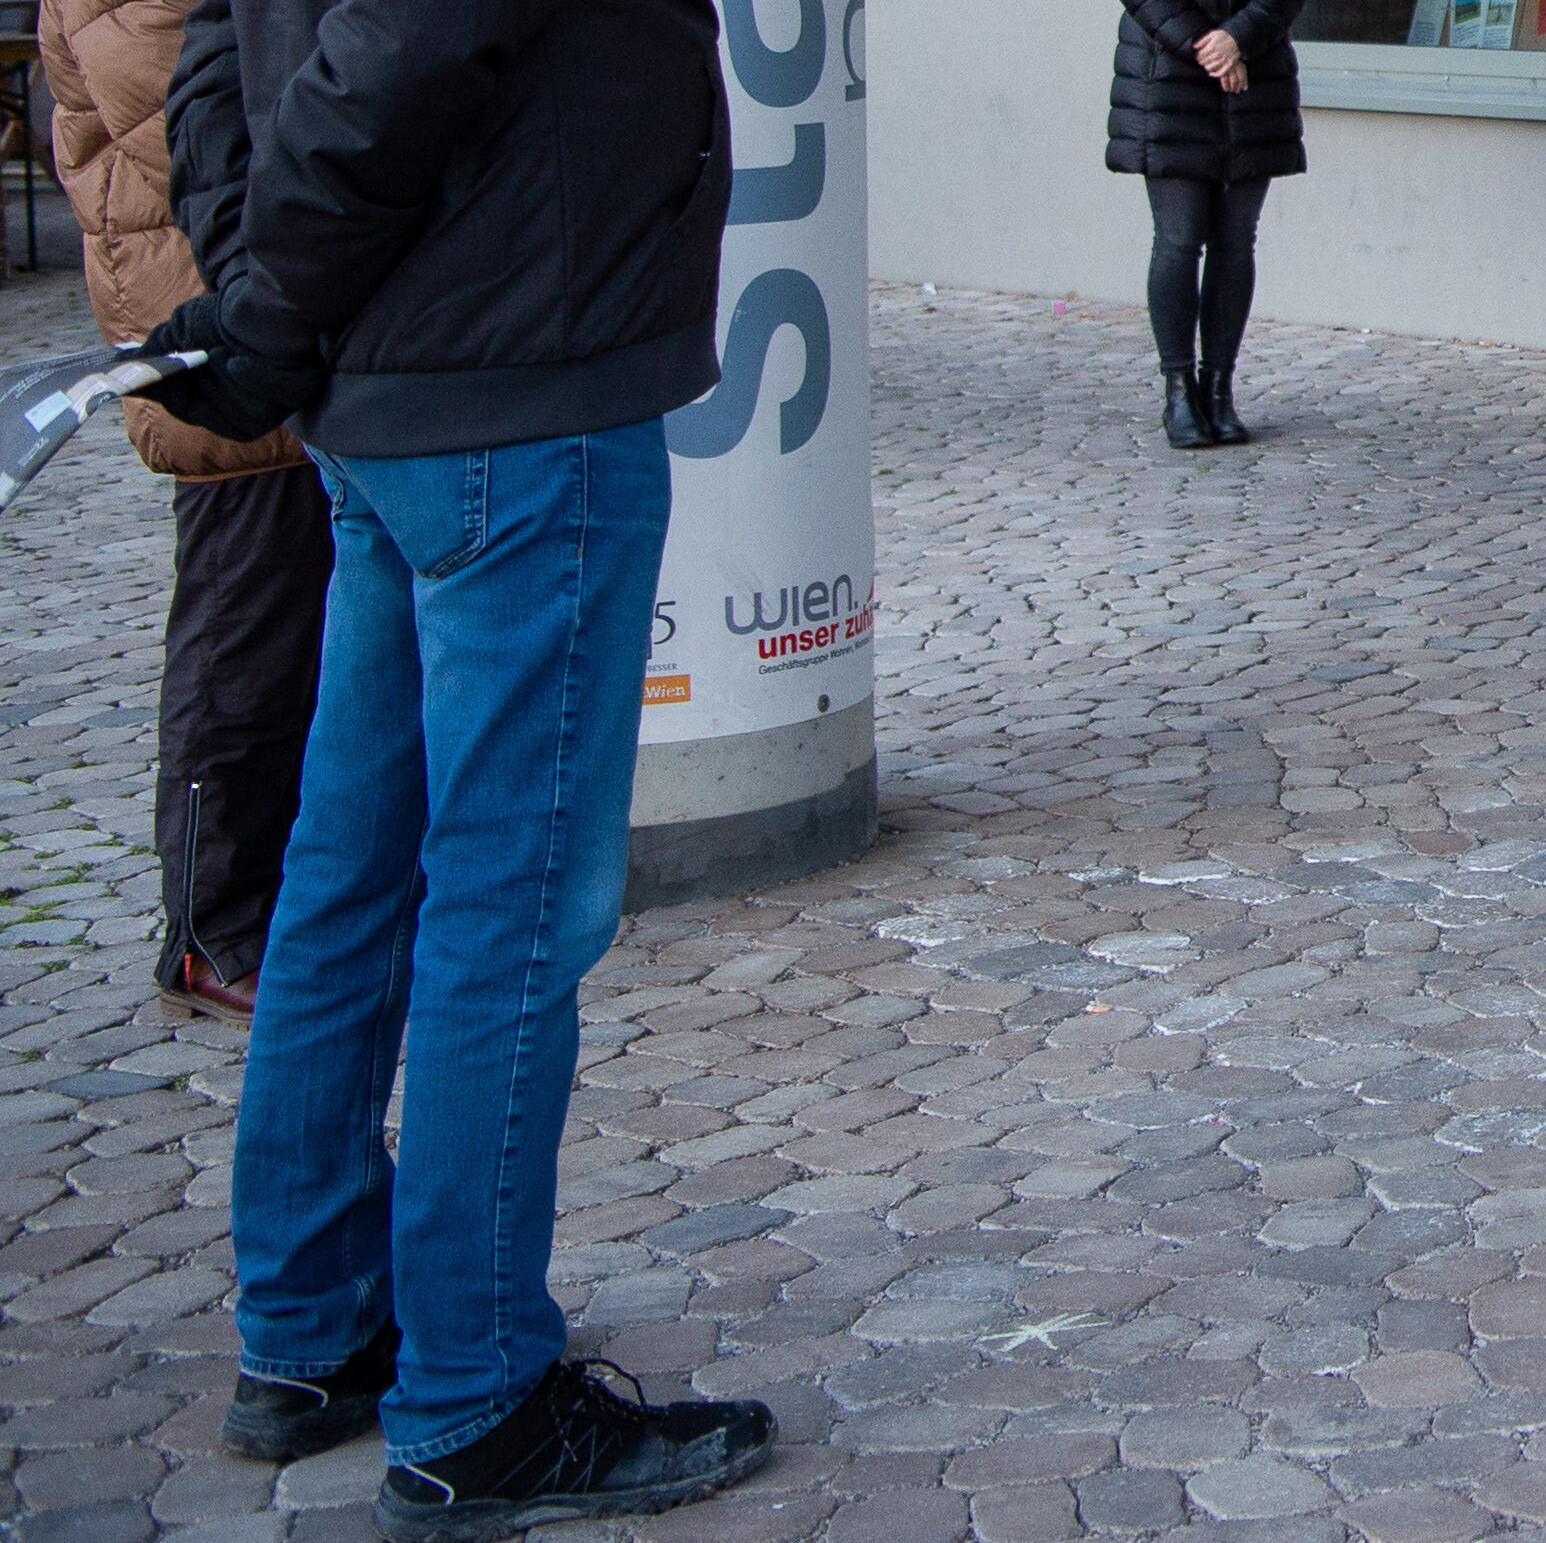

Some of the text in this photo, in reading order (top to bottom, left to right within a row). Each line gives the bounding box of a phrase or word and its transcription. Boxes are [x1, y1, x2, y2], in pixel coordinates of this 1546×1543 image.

[757, 621, 840, 660] unser
[758, 652, 829, 675] Geschäftsgruppe
[646, 685, 686, 699] Wien
